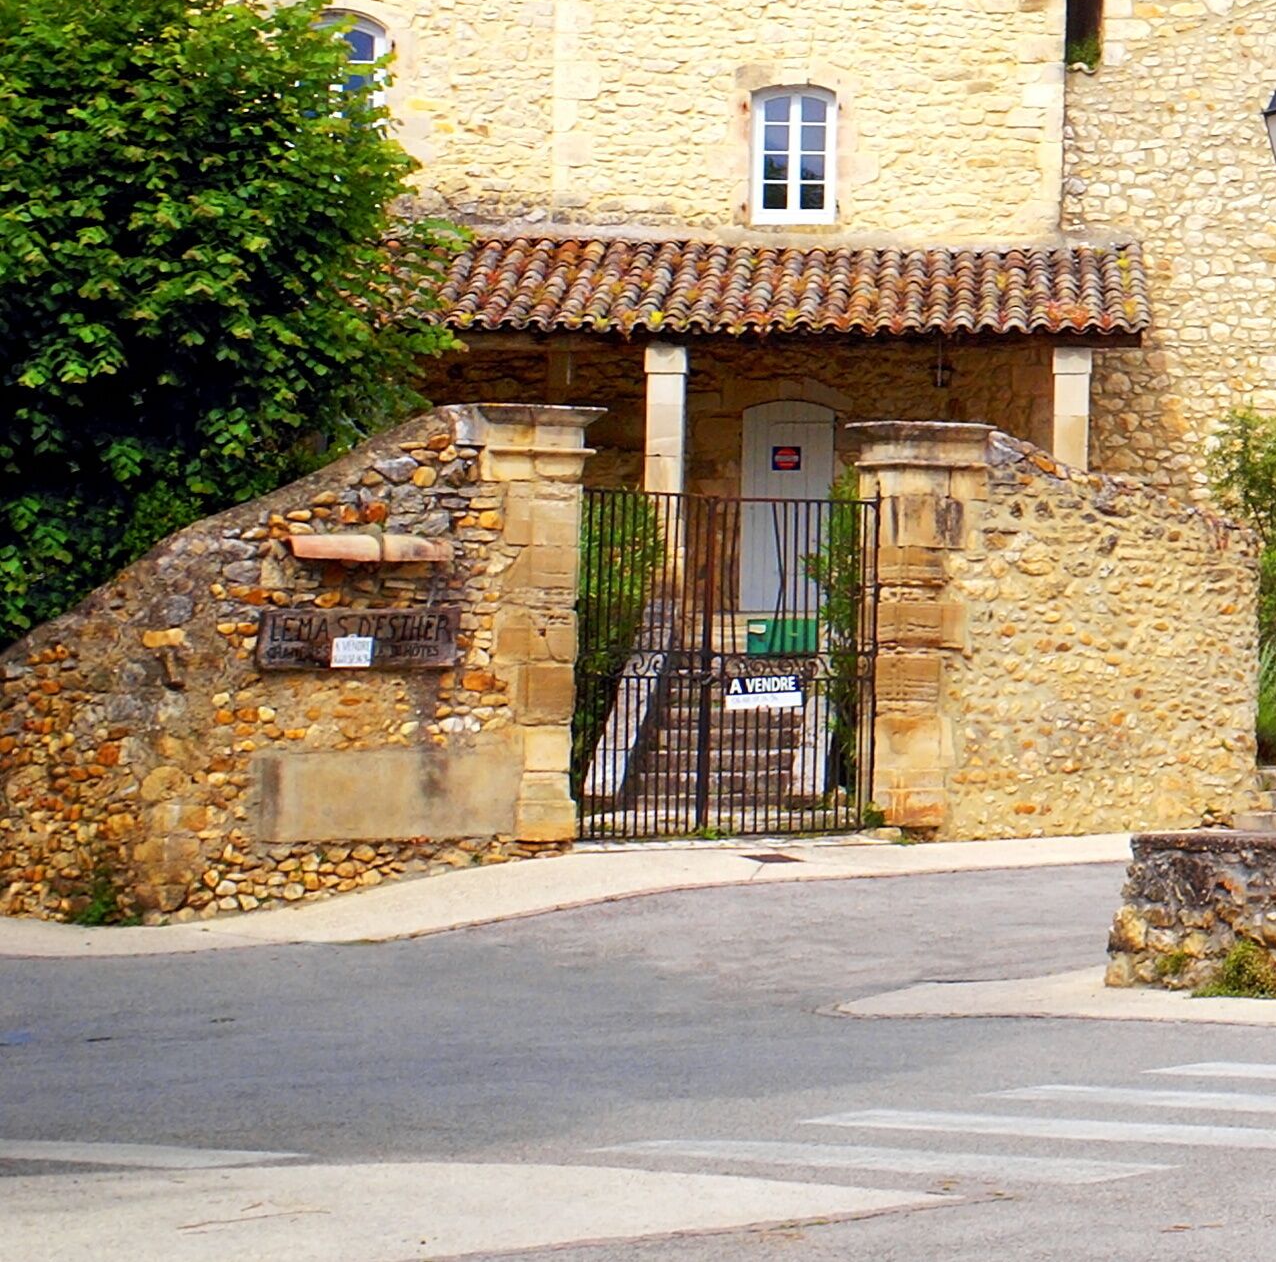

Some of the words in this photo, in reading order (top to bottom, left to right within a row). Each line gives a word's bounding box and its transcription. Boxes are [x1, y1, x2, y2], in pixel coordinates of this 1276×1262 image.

[358, 614, 453, 643] D'ESTHER
[729, 678, 743, 694] A
[745, 675, 797, 693] VENDRE
